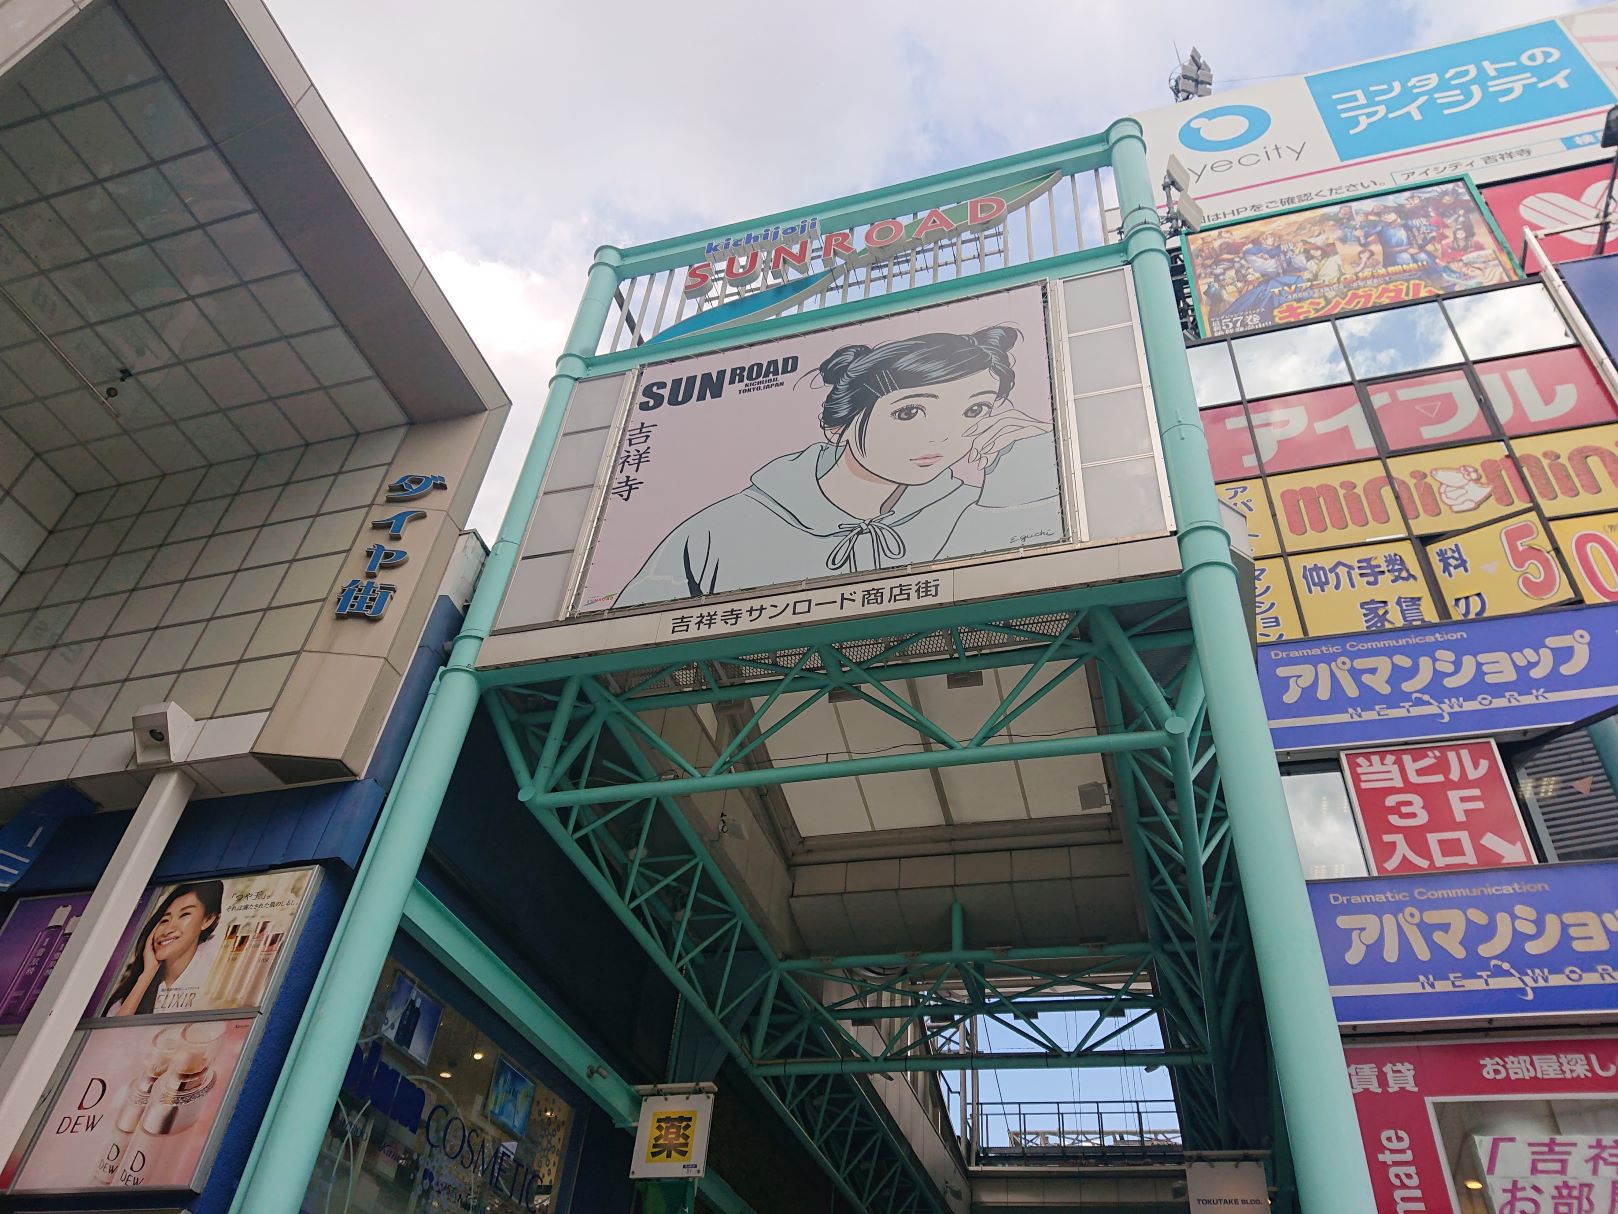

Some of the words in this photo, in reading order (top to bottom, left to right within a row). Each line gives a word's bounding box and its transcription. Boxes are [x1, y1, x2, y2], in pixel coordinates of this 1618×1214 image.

[1332, 45, 1561, 107] コンタクトの
[1340, 69, 1573, 135] アイシティ
[683, 196, 1007, 293] SUNROAD
[704, 216, 819, 254] kichijoji
[638, 368, 727, 412] SUN
[728, 355, 799, 386] ROAD
[1224, 367, 1579, 469] アイフル
[611, 421, 658, 502] 吉祥寺
[1481, 439, 1618, 508] min
[335, 474, 448, 620] ダイヤ街
[670, 578, 940, 636] 吉祥寺サンロード商店街
[1270, 644, 1343, 660] Dramatic
[1345, 629, 1468, 652] Communication
[1275, 628, 1591, 704] アパマンショップ
[1355, 748, 1490, 790] 当ビル
[1382, 830, 1479, 871] 入口
[1329, 890, 1409, 906] Dramatic
[1413, 881, 1550, 901] Communication
[1347, 1062, 1419, 1094] 賃貸
[1479, 1054, 1617, 1081] お部屋探し
[56, 1114, 104, 1135] DEW
[650, 1115, 693, 1159] 薬
[425, 1103, 550, 1214] COSMETIC
[1196, 1198, 1240, 1206] TOKUTAKE
[1501, 1179, 1618, 1214] お部
